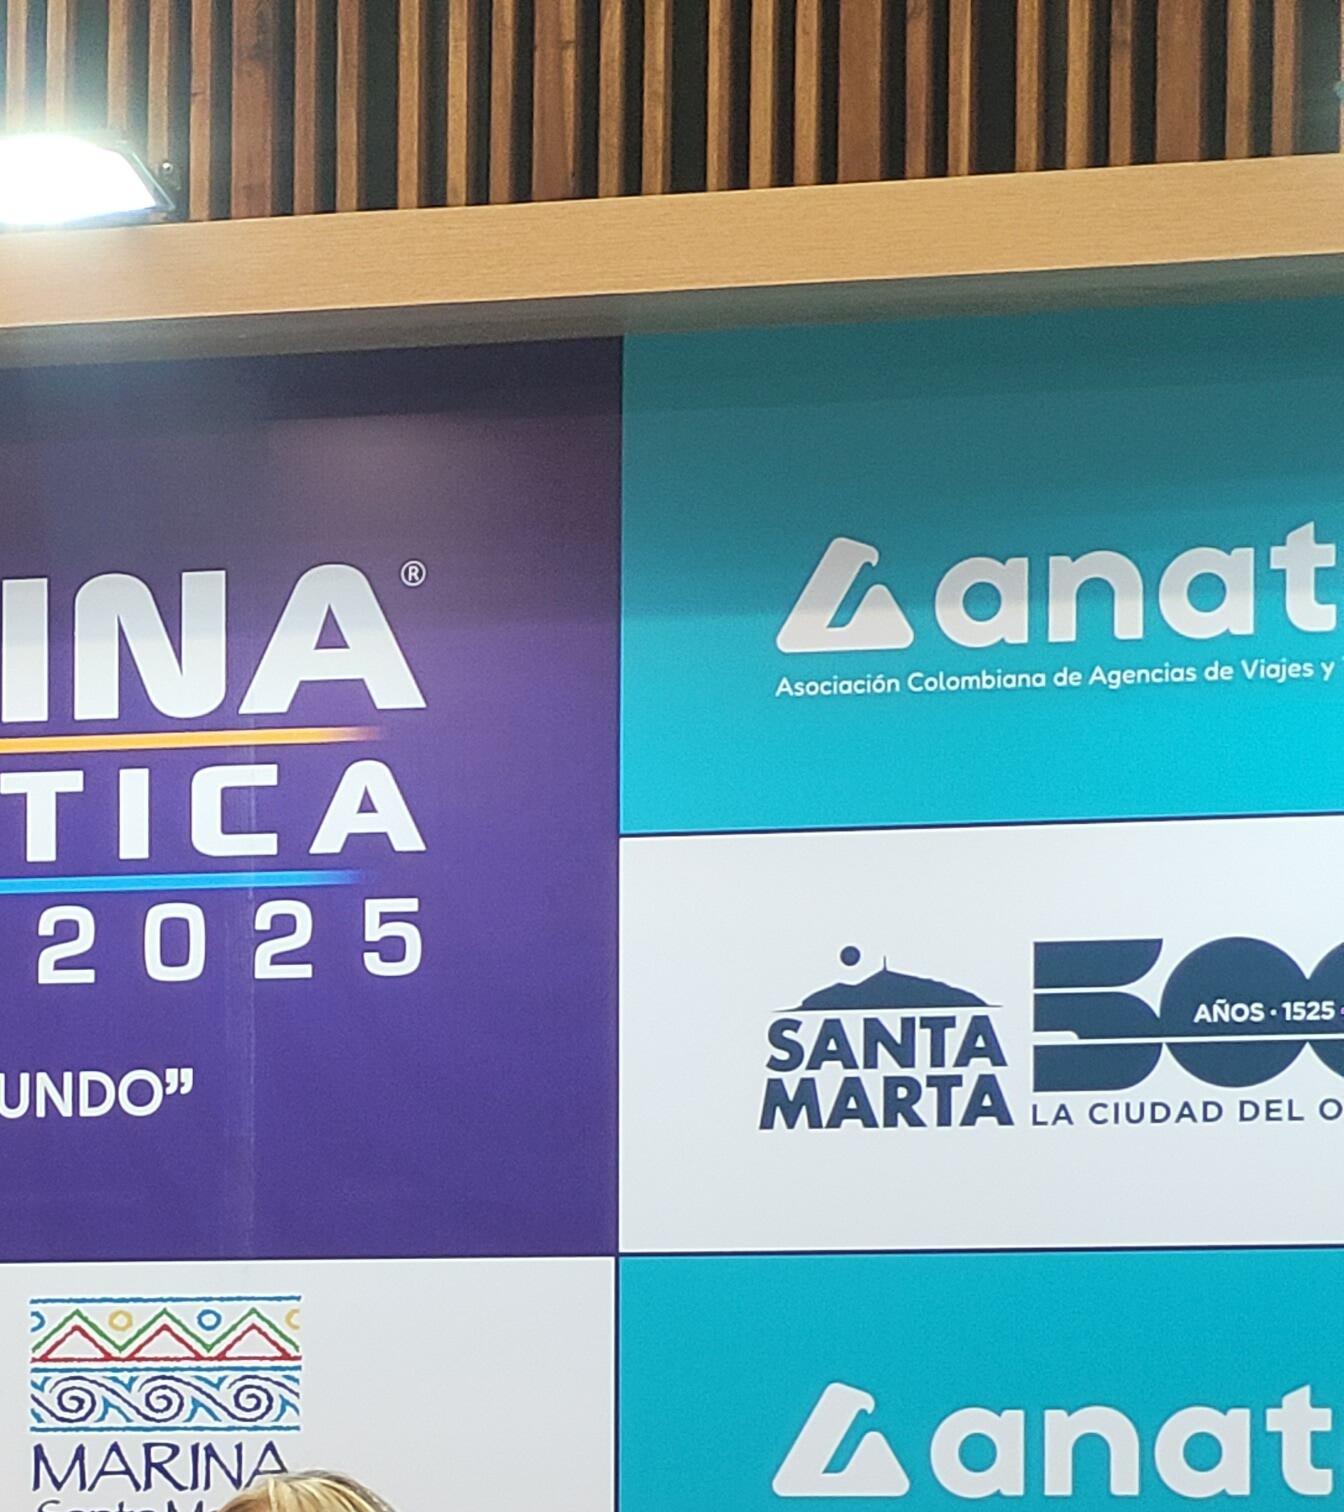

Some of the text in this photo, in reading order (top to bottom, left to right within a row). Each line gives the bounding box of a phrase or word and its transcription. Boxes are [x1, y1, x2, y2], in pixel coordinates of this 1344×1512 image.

[934, 520, 1338, 649] anat
[775, 657, 1335, 697] Asociación Colombiana de Agencias de Viajes y
[36, 896, 424, 986] 2025
[1193, 998, 1336, 1023] AÑOS 1525
[765, 1014, 1008, 1073] SANTA
[758, 1073, 1016, 1131] MARTA
[1032, 1098, 1305, 1126] LA CIUDAD DEL
[31, 1440, 290, 1493] MARINA
[928, 1384, 1334, 1499] anat
